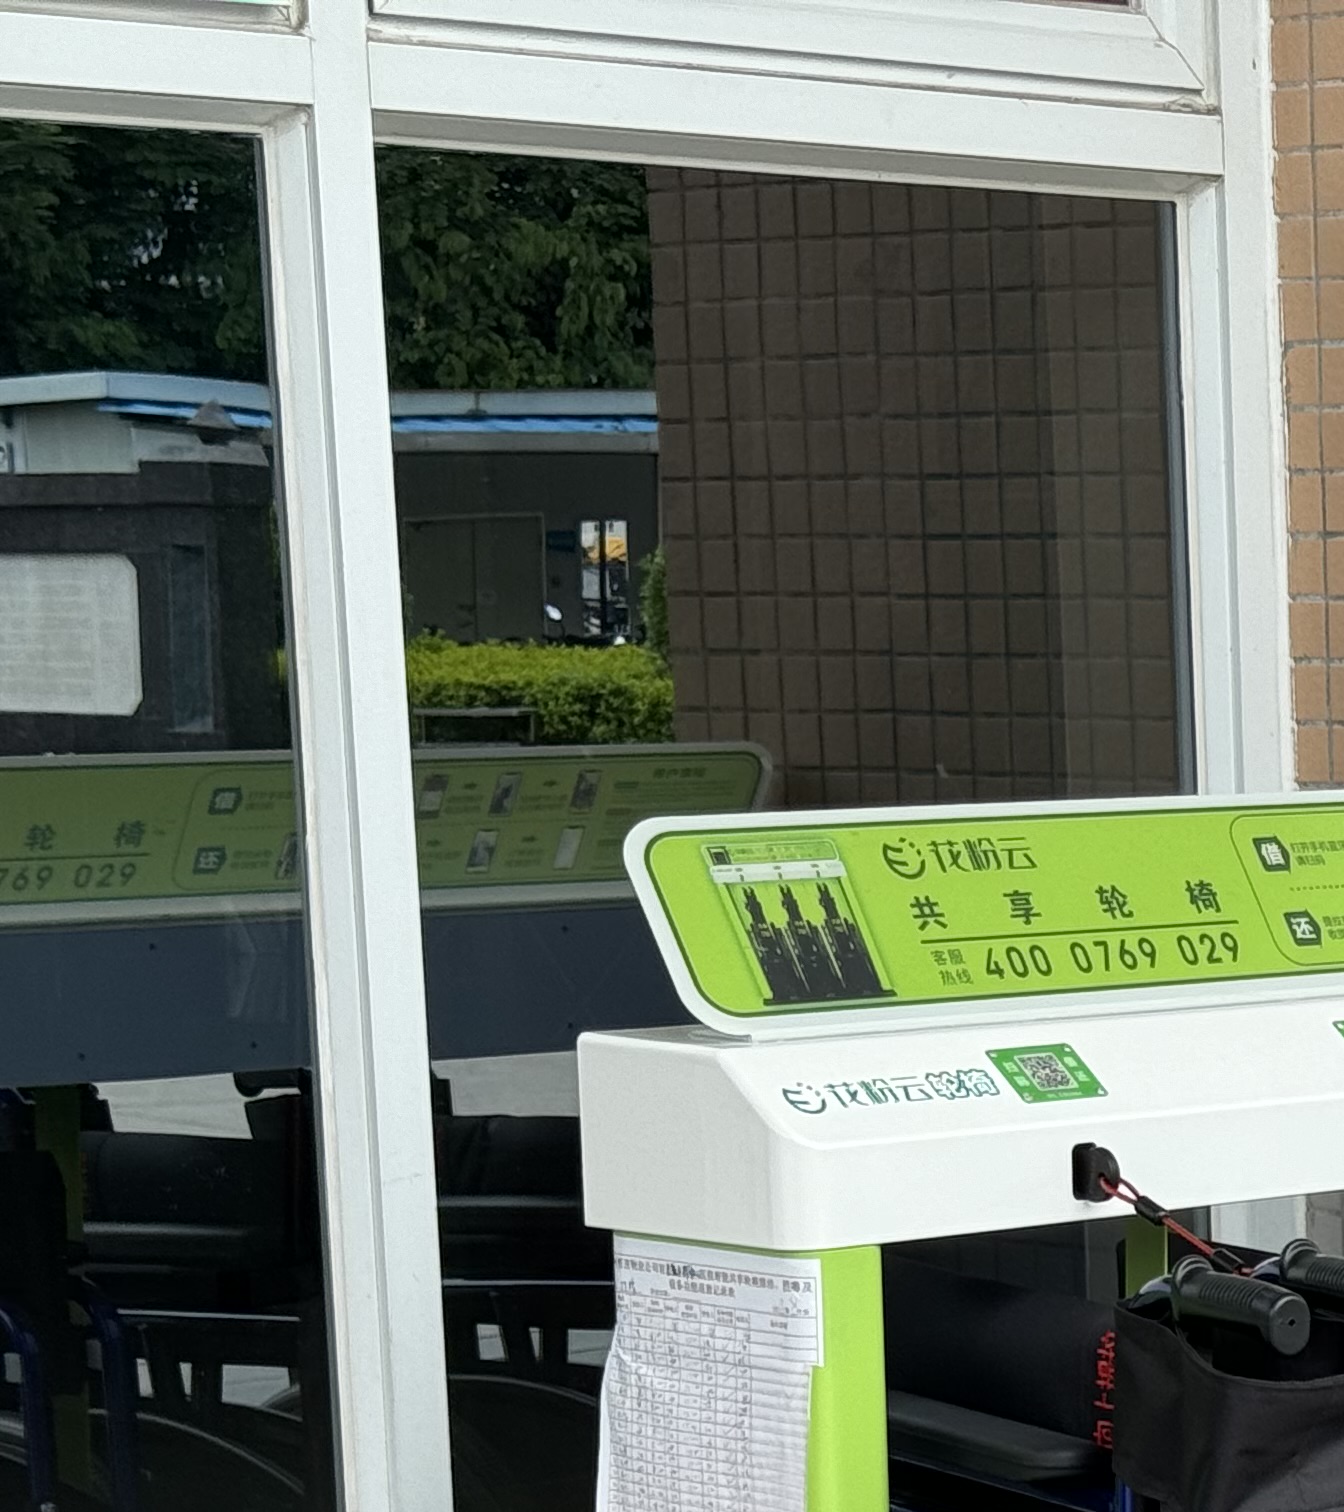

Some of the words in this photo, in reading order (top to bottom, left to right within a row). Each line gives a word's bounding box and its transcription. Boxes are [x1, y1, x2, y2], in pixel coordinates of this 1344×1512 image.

[926, 837, 1038, 873] 花粉云
[1260, 841, 1286, 866] 借
[73, 862, 137, 889] 029
[910, 879, 1222, 932] 共享轮椅
[1291, 916, 1317, 940] 还
[986, 944, 1053, 980] 400
[1069, 937, 1157, 974] 0769
[1176, 931, 1239, 966] 029
